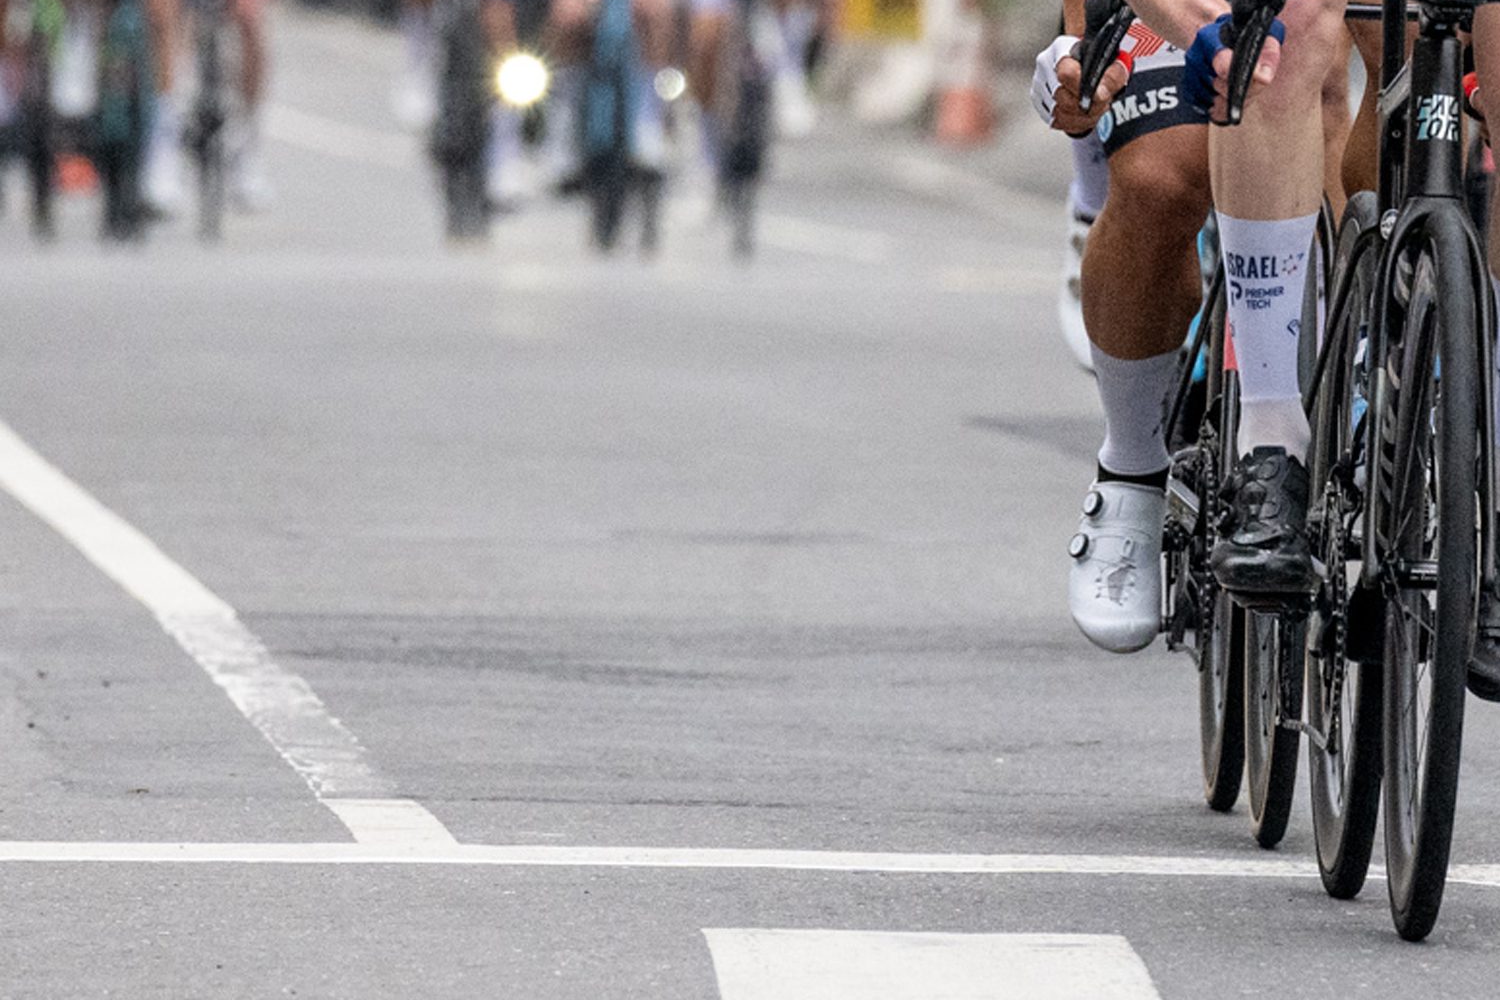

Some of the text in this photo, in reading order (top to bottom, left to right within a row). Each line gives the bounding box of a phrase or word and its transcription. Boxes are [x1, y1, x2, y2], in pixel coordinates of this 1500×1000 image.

[1111, 85, 1179, 126] MJS
[1245, 286, 1285, 298] PREMIER
[1246, 299, 1272, 311] TECH
